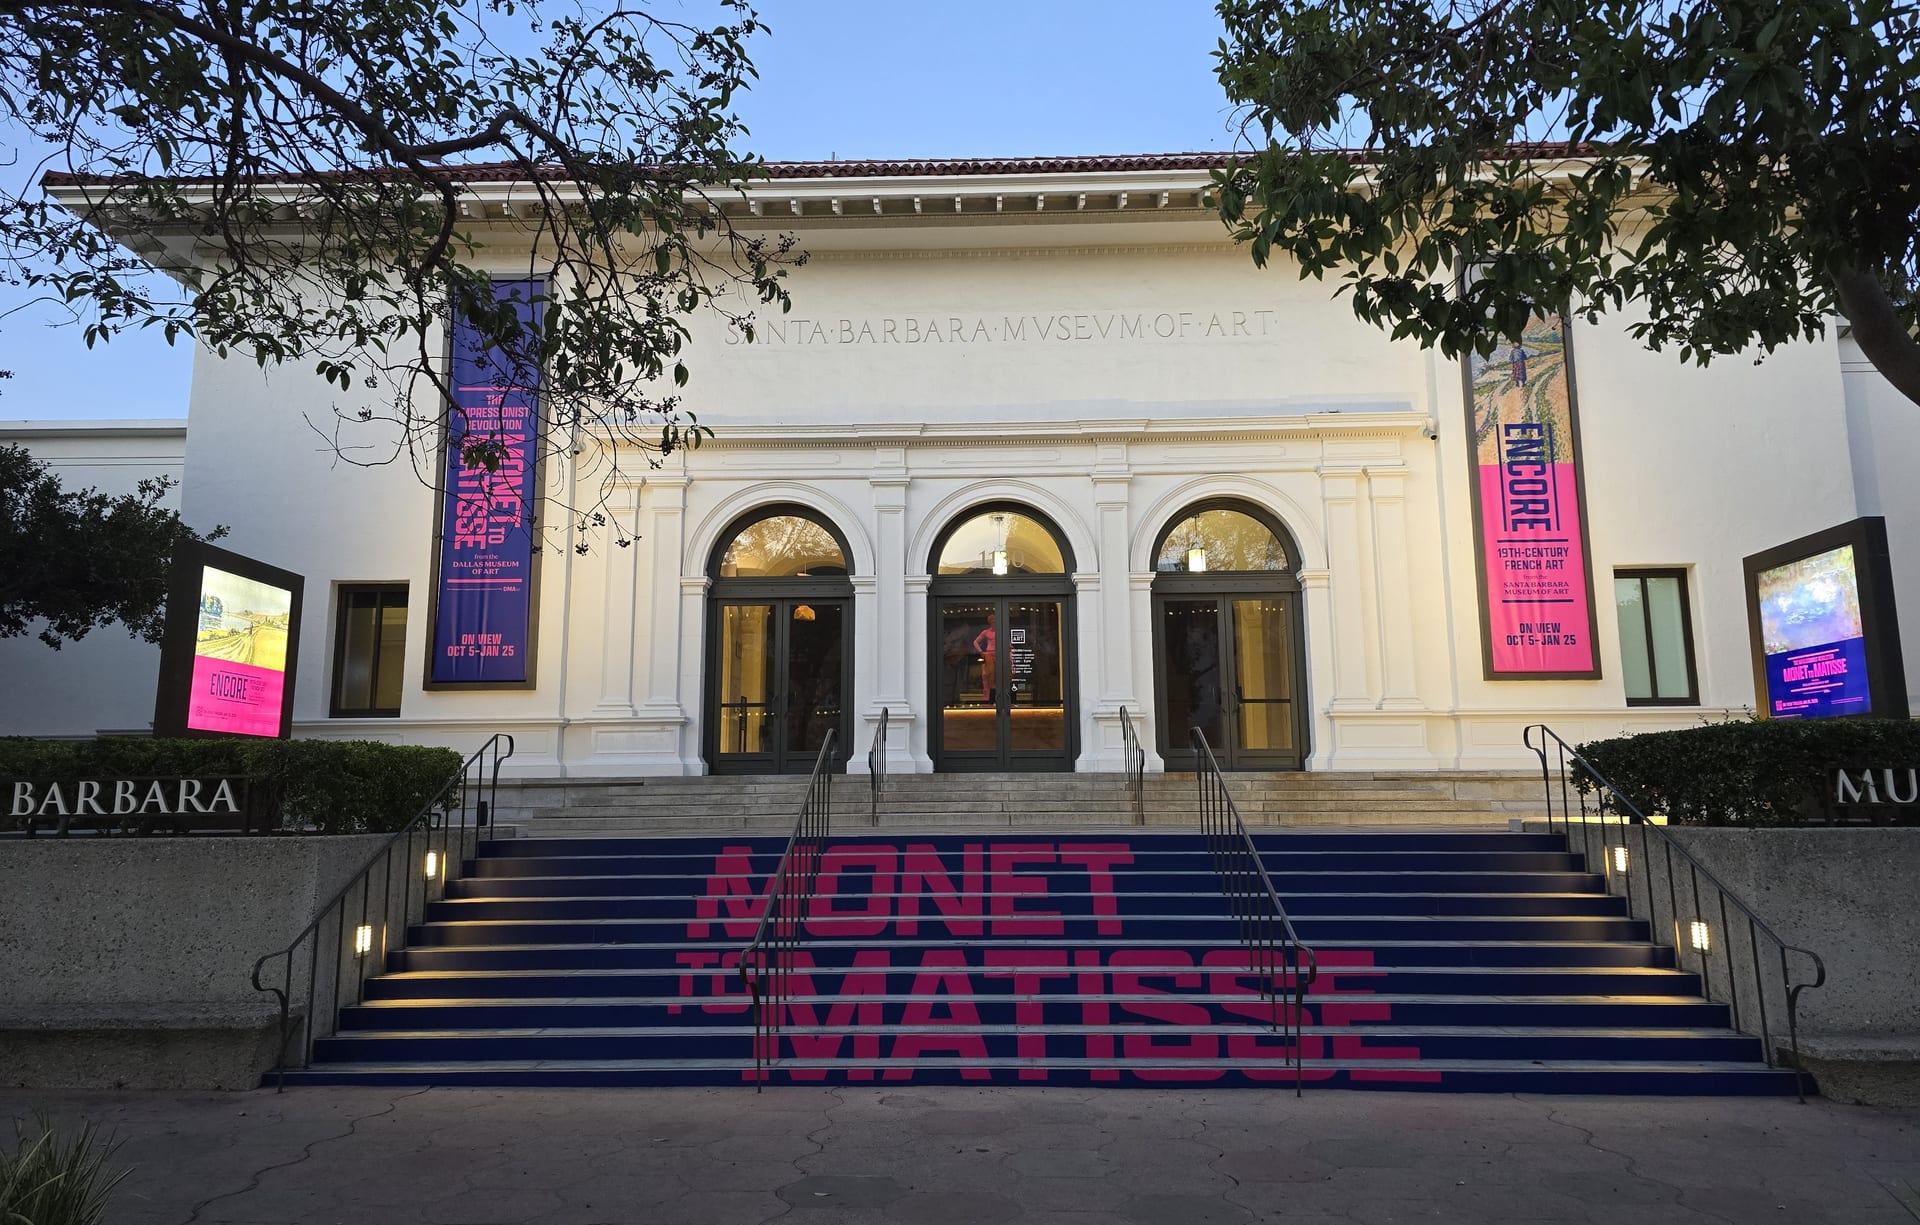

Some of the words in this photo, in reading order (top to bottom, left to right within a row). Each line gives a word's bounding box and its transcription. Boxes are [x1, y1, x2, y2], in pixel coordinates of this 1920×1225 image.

[838, 317, 993, 345] BARBARA
[1002, 313, 1145, 342] MVSEVM
[1153, 312, 1193, 338] OF
[1204, 310, 1275, 337] ART
[457, 407, 530, 418] IMPRESSONIST
[1504, 423, 1552, 532] ENCORE
[487, 527, 505, 544] TO
[1497, 547, 1569, 558] 19TH-CENTURY
[1504, 560, 1542, 570] FRENCH
[1546, 560, 1564, 570] ART
[1520, 623, 1532, 634] ON
[1536, 623, 1561, 633] VIEW
[462, 634, 475, 645] ON
[478, 634, 502, 645] VIEW
[1506, 635, 1524, 646] OCT
[1564, 634, 1576, 645] 25
[448, 646, 466, 656] OCT
[502, 645, 515, 656] 25
[1783, 664, 1809, 682] MONET
[1813, 658, 1848, 678] MATISSE
[210, 673, 248, 700] ENCORE
[1837, 768, 1918, 804] MU
[8, 778, 241, 816] BARBARA
[687, 843, 1135, 938] MONET
[667, 951, 765, 1014] TO
[741, 949, 1442, 1083] MATISSE
